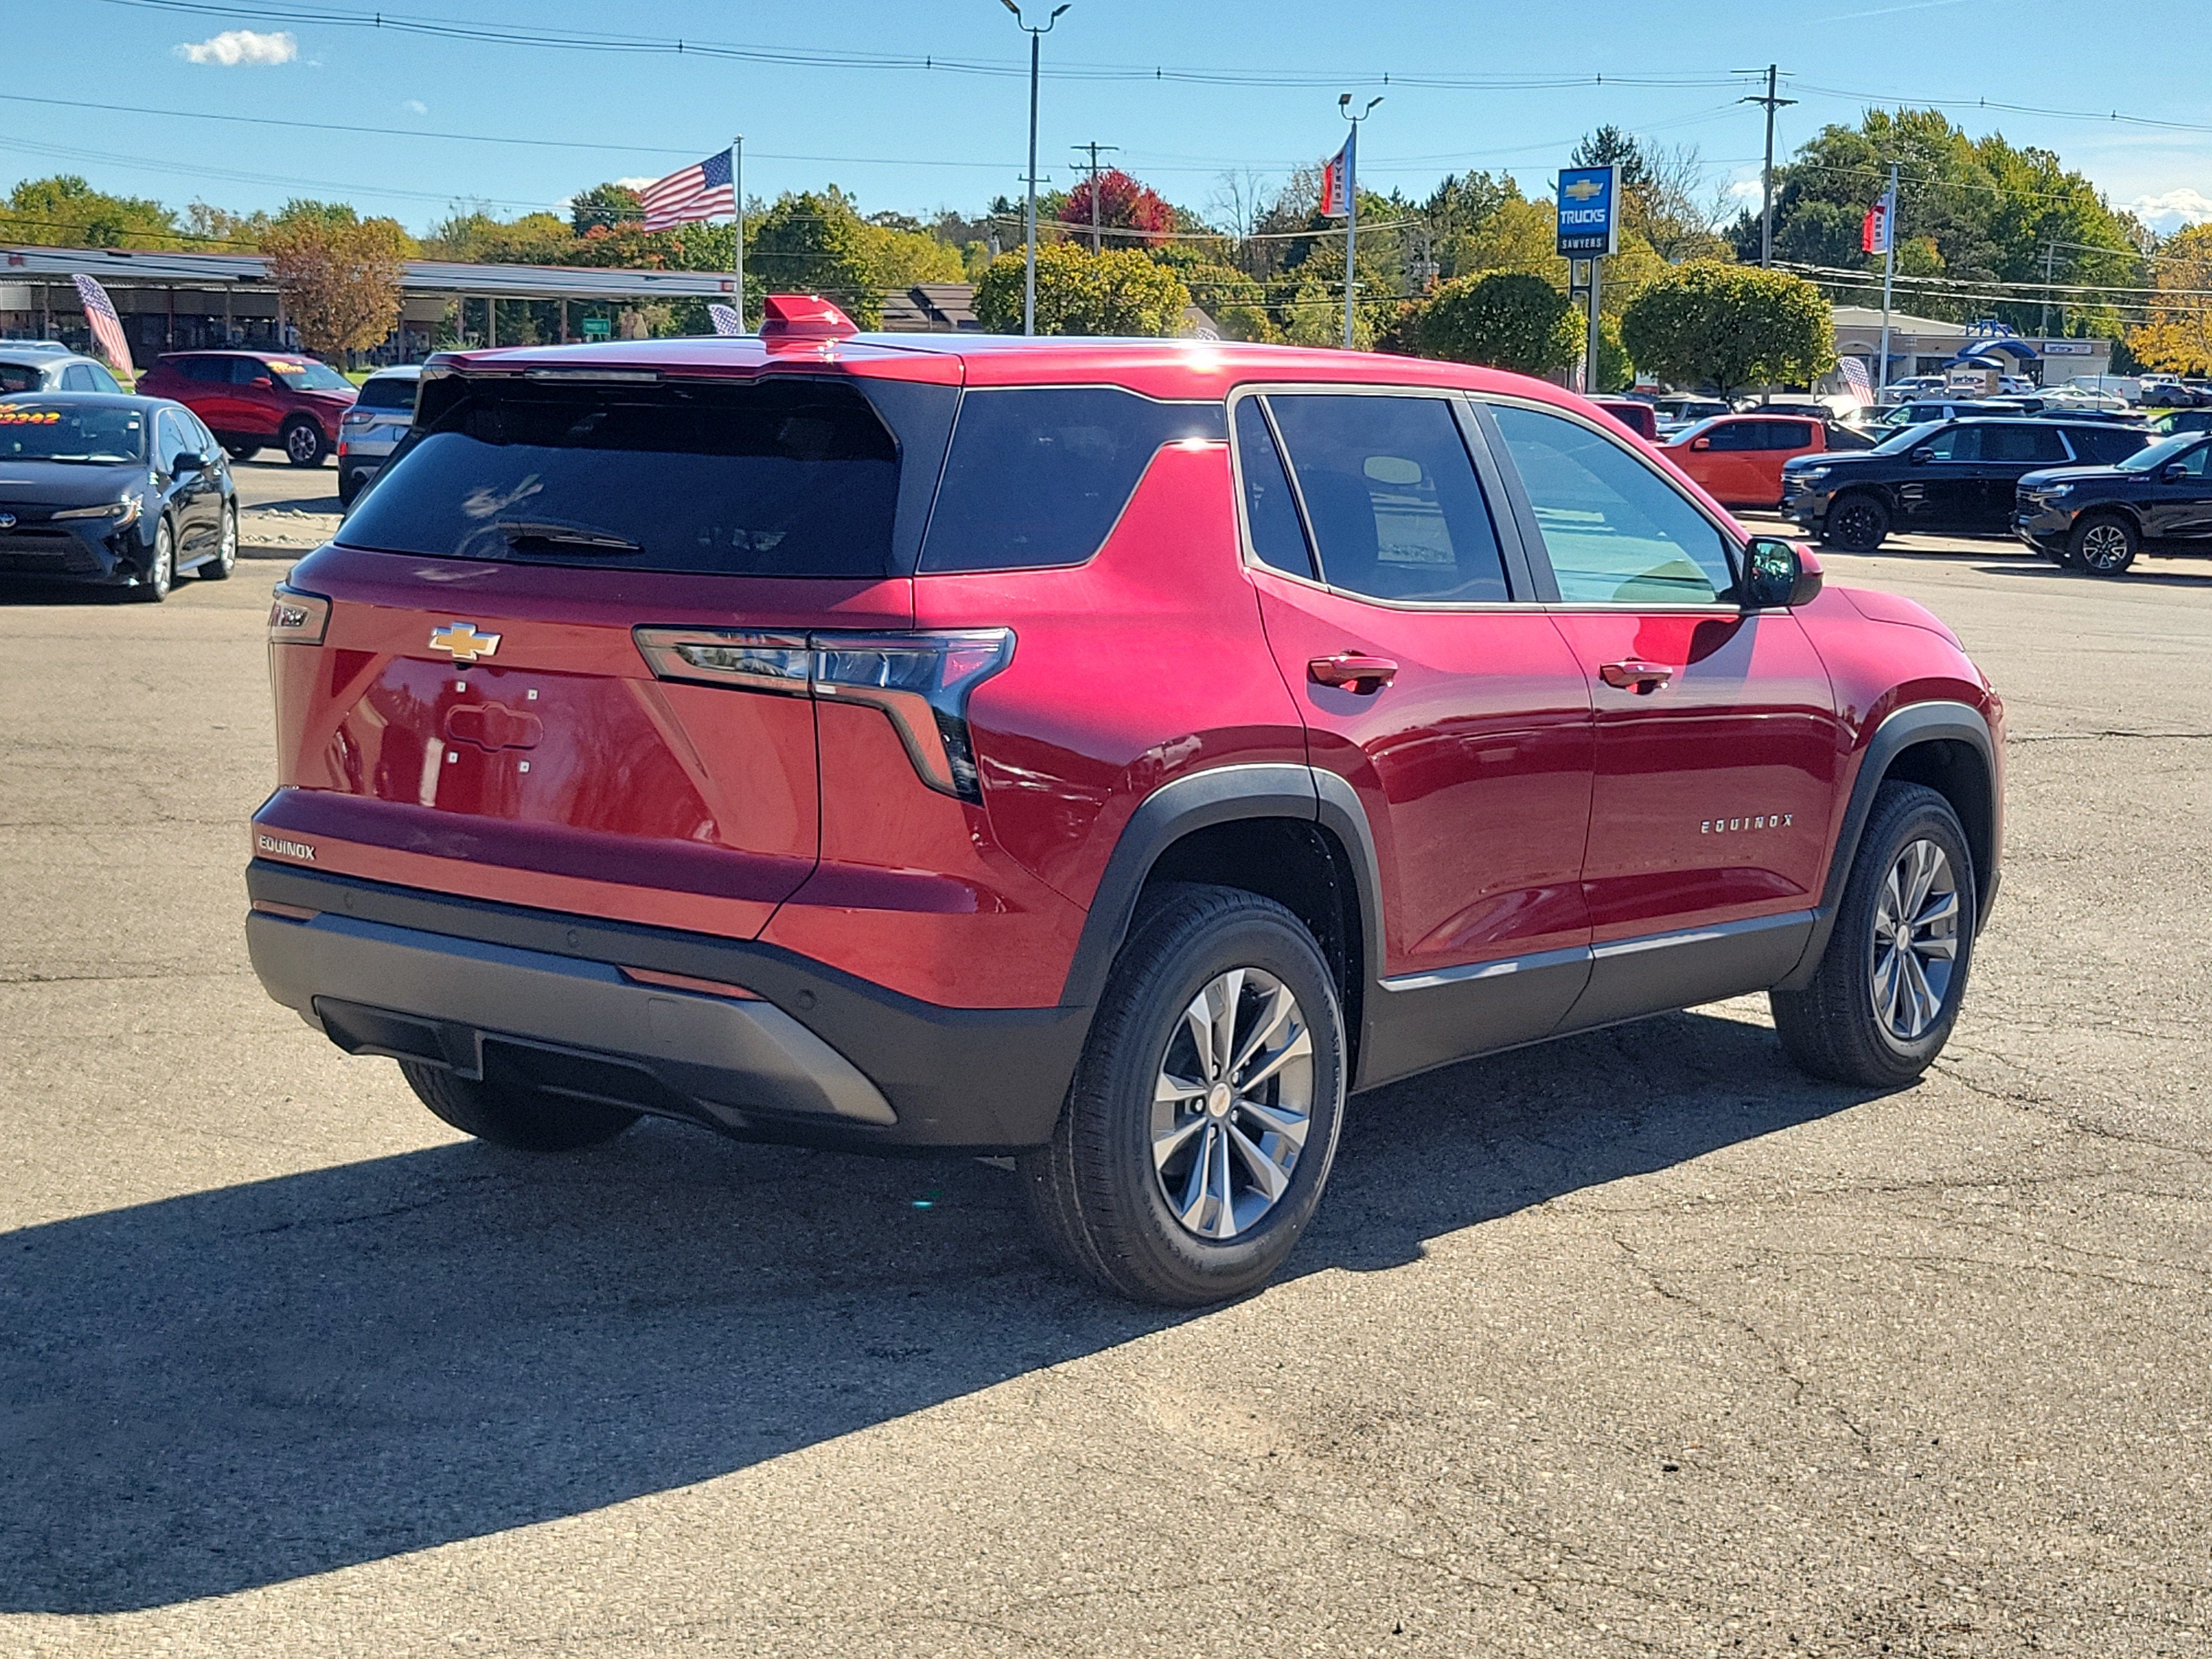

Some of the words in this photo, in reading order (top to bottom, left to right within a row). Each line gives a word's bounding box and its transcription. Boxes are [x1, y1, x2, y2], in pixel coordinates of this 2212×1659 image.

[1560, 208, 1606, 225] TRUCKS
[1562, 238, 1601, 249] SAWYERS
[1701, 814, 1792, 834] EQUINOX
[259, 834, 315, 860] EQUINOX
